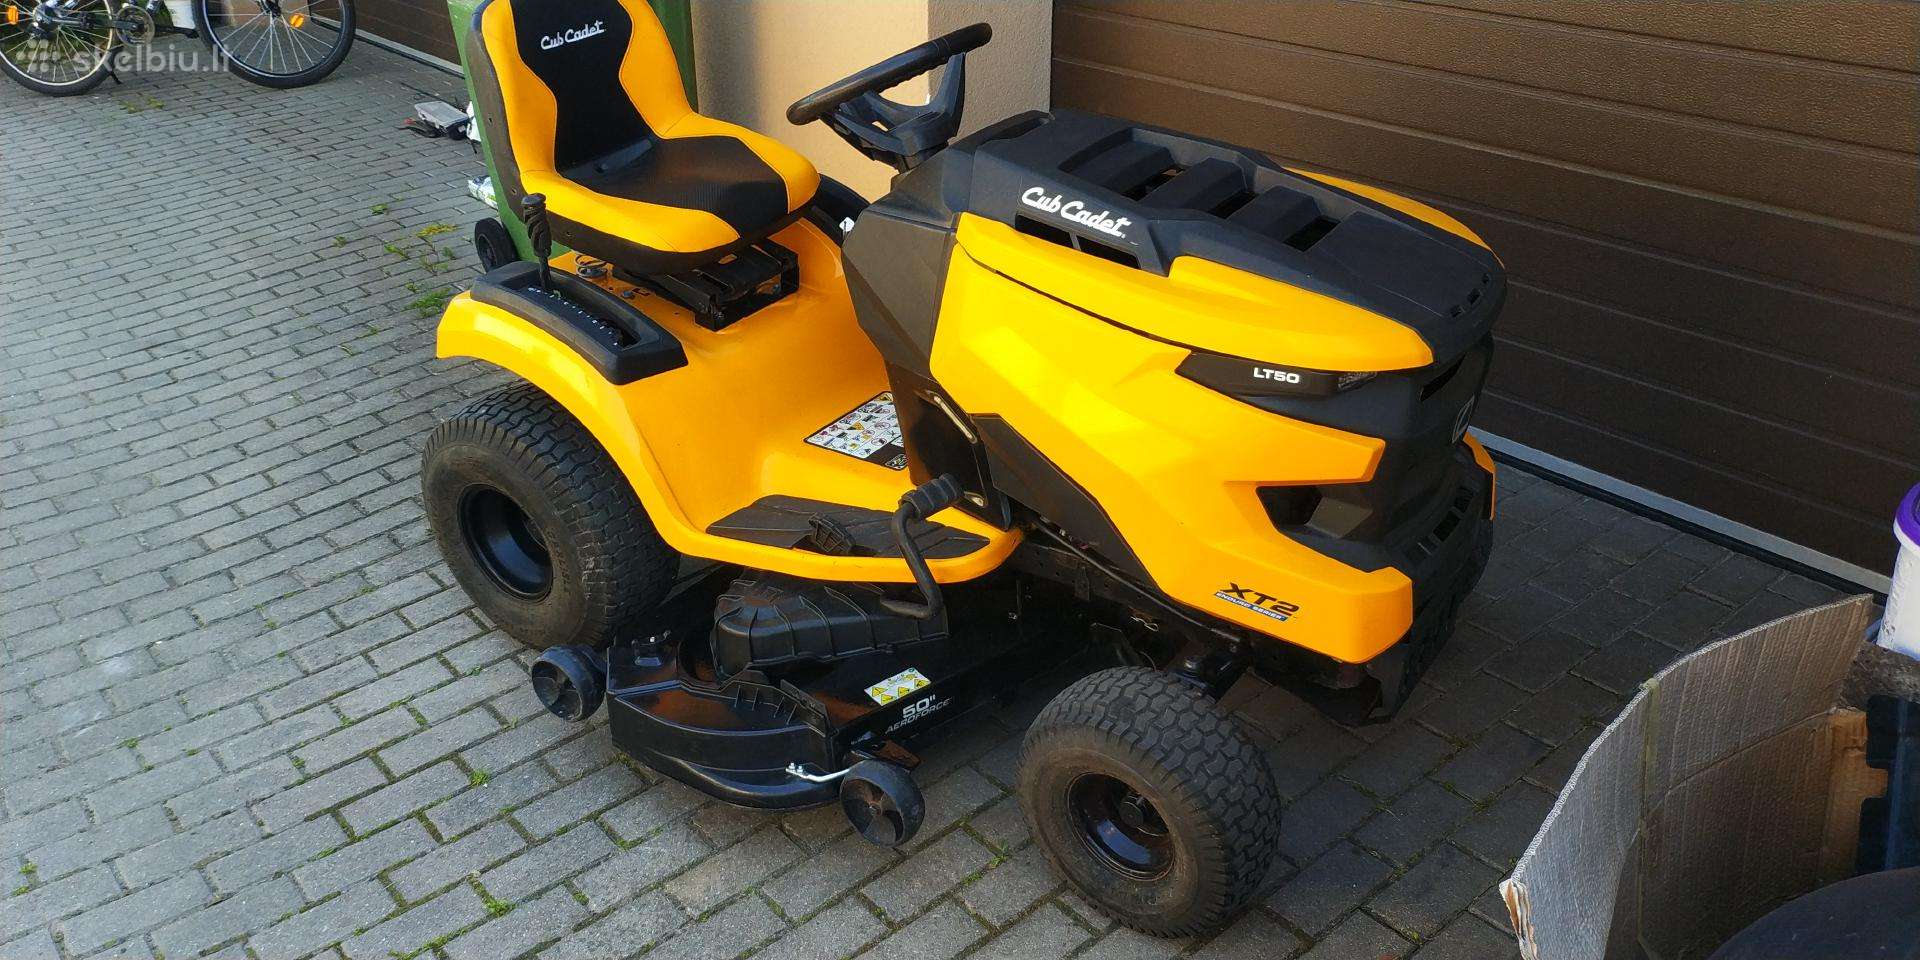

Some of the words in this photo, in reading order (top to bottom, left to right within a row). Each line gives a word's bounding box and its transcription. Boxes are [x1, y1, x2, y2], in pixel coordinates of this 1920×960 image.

[540, 32, 564, 50] Cub
[564, 20, 605, 43] Cadet
[1021, 187, 1062, 213] Cub
[1060, 200, 1132, 237] Cadet
[1253, 367, 1300, 384] LT50
[1220, 582, 1300, 617] XT2
[885, 698, 952, 734] AEROFORCE
